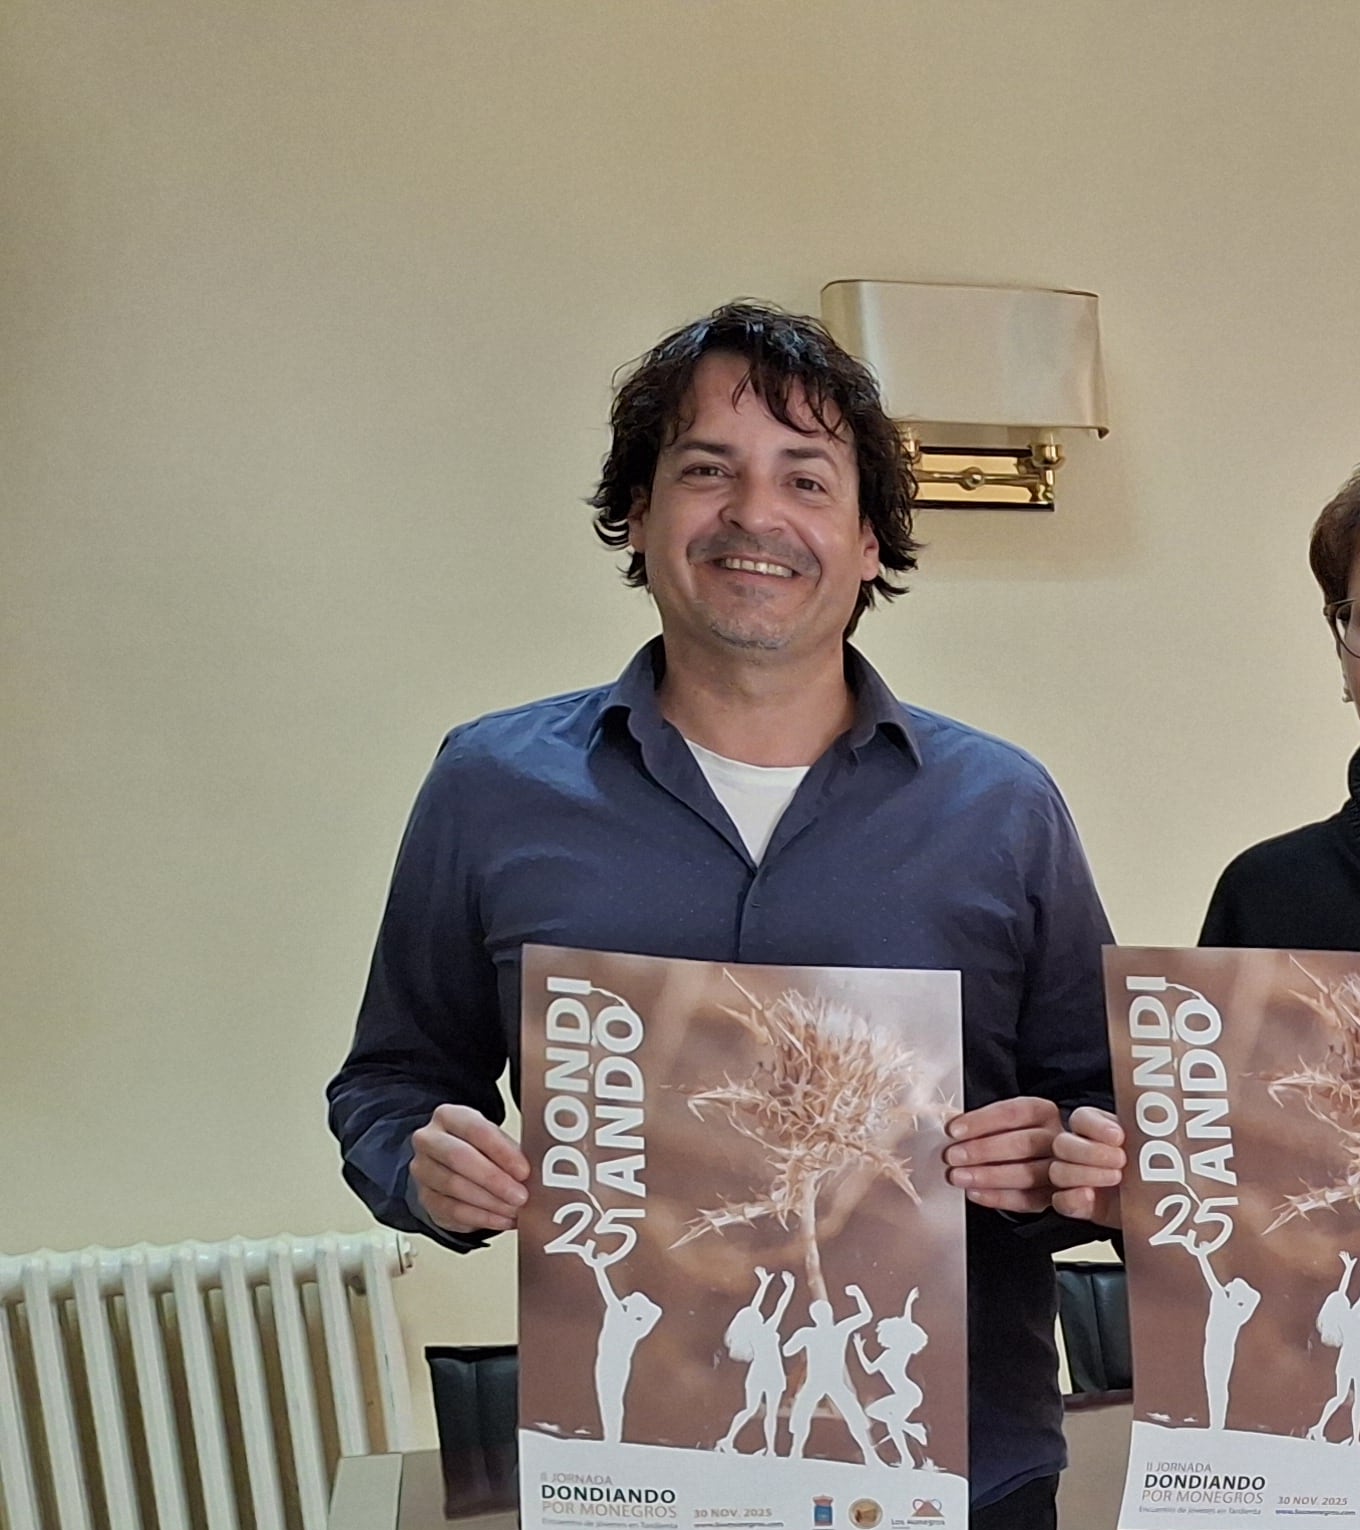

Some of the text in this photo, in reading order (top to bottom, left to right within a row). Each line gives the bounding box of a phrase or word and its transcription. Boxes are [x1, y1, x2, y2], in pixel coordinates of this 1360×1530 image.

[542, 976, 592, 1191] DONDI
[1126, 976, 1185, 1182] DONDI
[595, 1005, 646, 1196] ANDO
[1173, 998, 1238, 1187] ANDO
[1155, 1462, 1212, 1473] JORNADA
[551, 1472, 613, 1486] JORNADA
[1144, 1474, 1266, 1491] DONDIANDO
[541, 1484, 676, 1504] DONDIANDO
[1141, 1489, 1264, 1505] POR MONEGROS
[1277, 1496, 1291, 1505] 30
[1321, 1497, 1348, 1506] 2025
[542, 1501, 677, 1518] POR MONEGROS
[694, 1508, 708, 1518] 30
[744, 1507, 772, 1517] 2025
